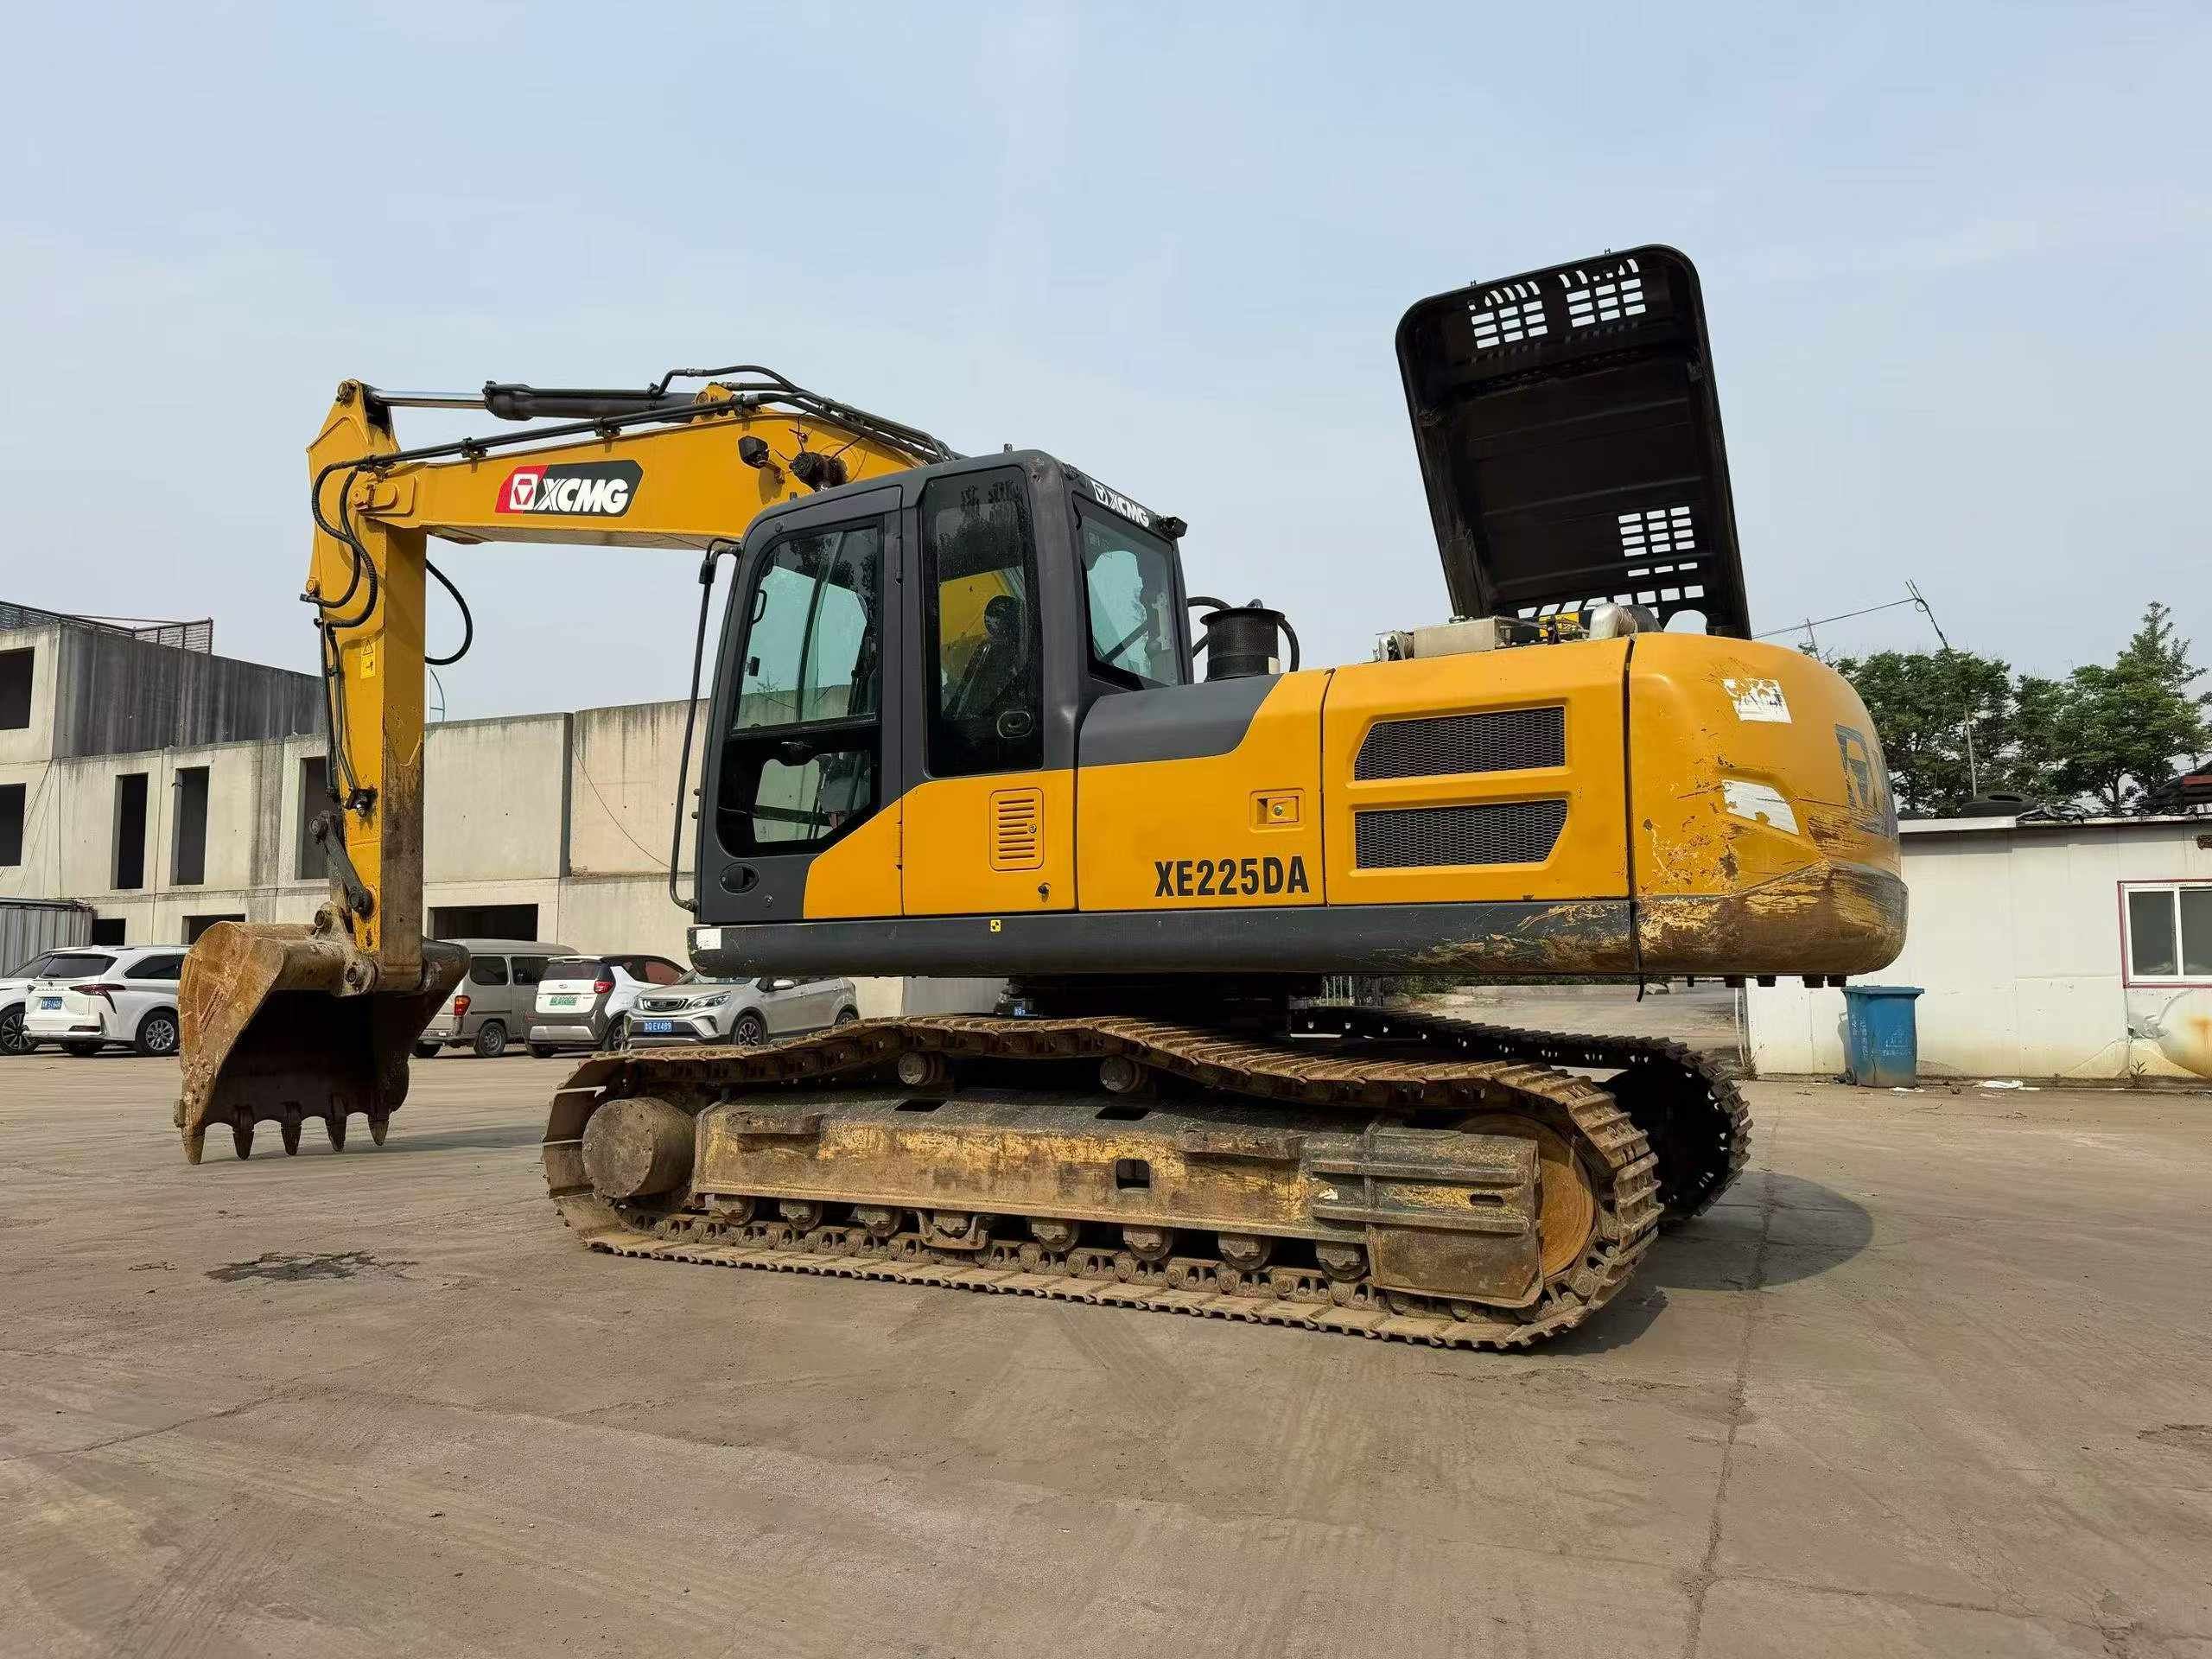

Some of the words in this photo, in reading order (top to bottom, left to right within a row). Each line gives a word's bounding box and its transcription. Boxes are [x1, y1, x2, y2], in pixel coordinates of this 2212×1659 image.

[534, 478, 628, 513] XCMG
[1107, 489, 1149, 527] XCMG
[1154, 855, 1310, 897] XE225DA
